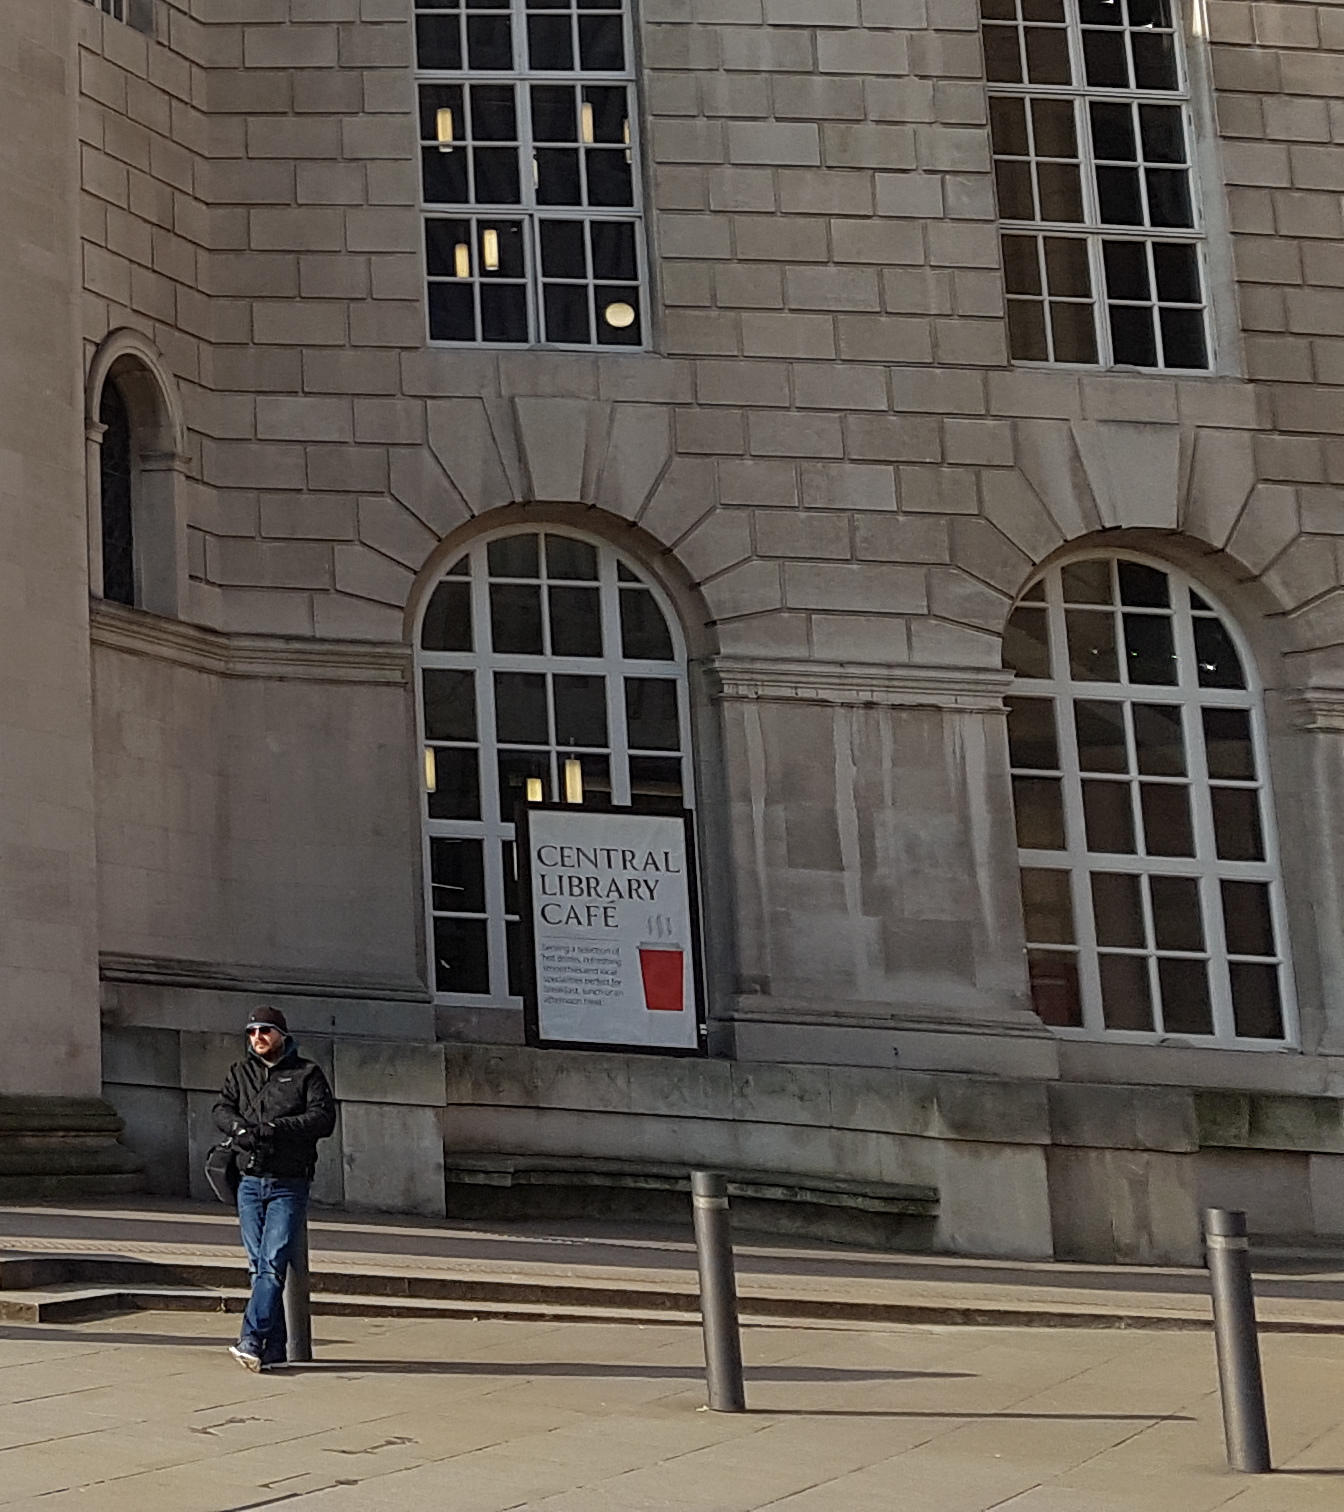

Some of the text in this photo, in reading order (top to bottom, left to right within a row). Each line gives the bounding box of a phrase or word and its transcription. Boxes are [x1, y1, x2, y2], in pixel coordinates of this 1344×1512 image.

[537, 845, 680, 873] CENTRAL
[540, 873, 659, 901] LIBRARY
[540, 900, 619, 928] CAFÉ
